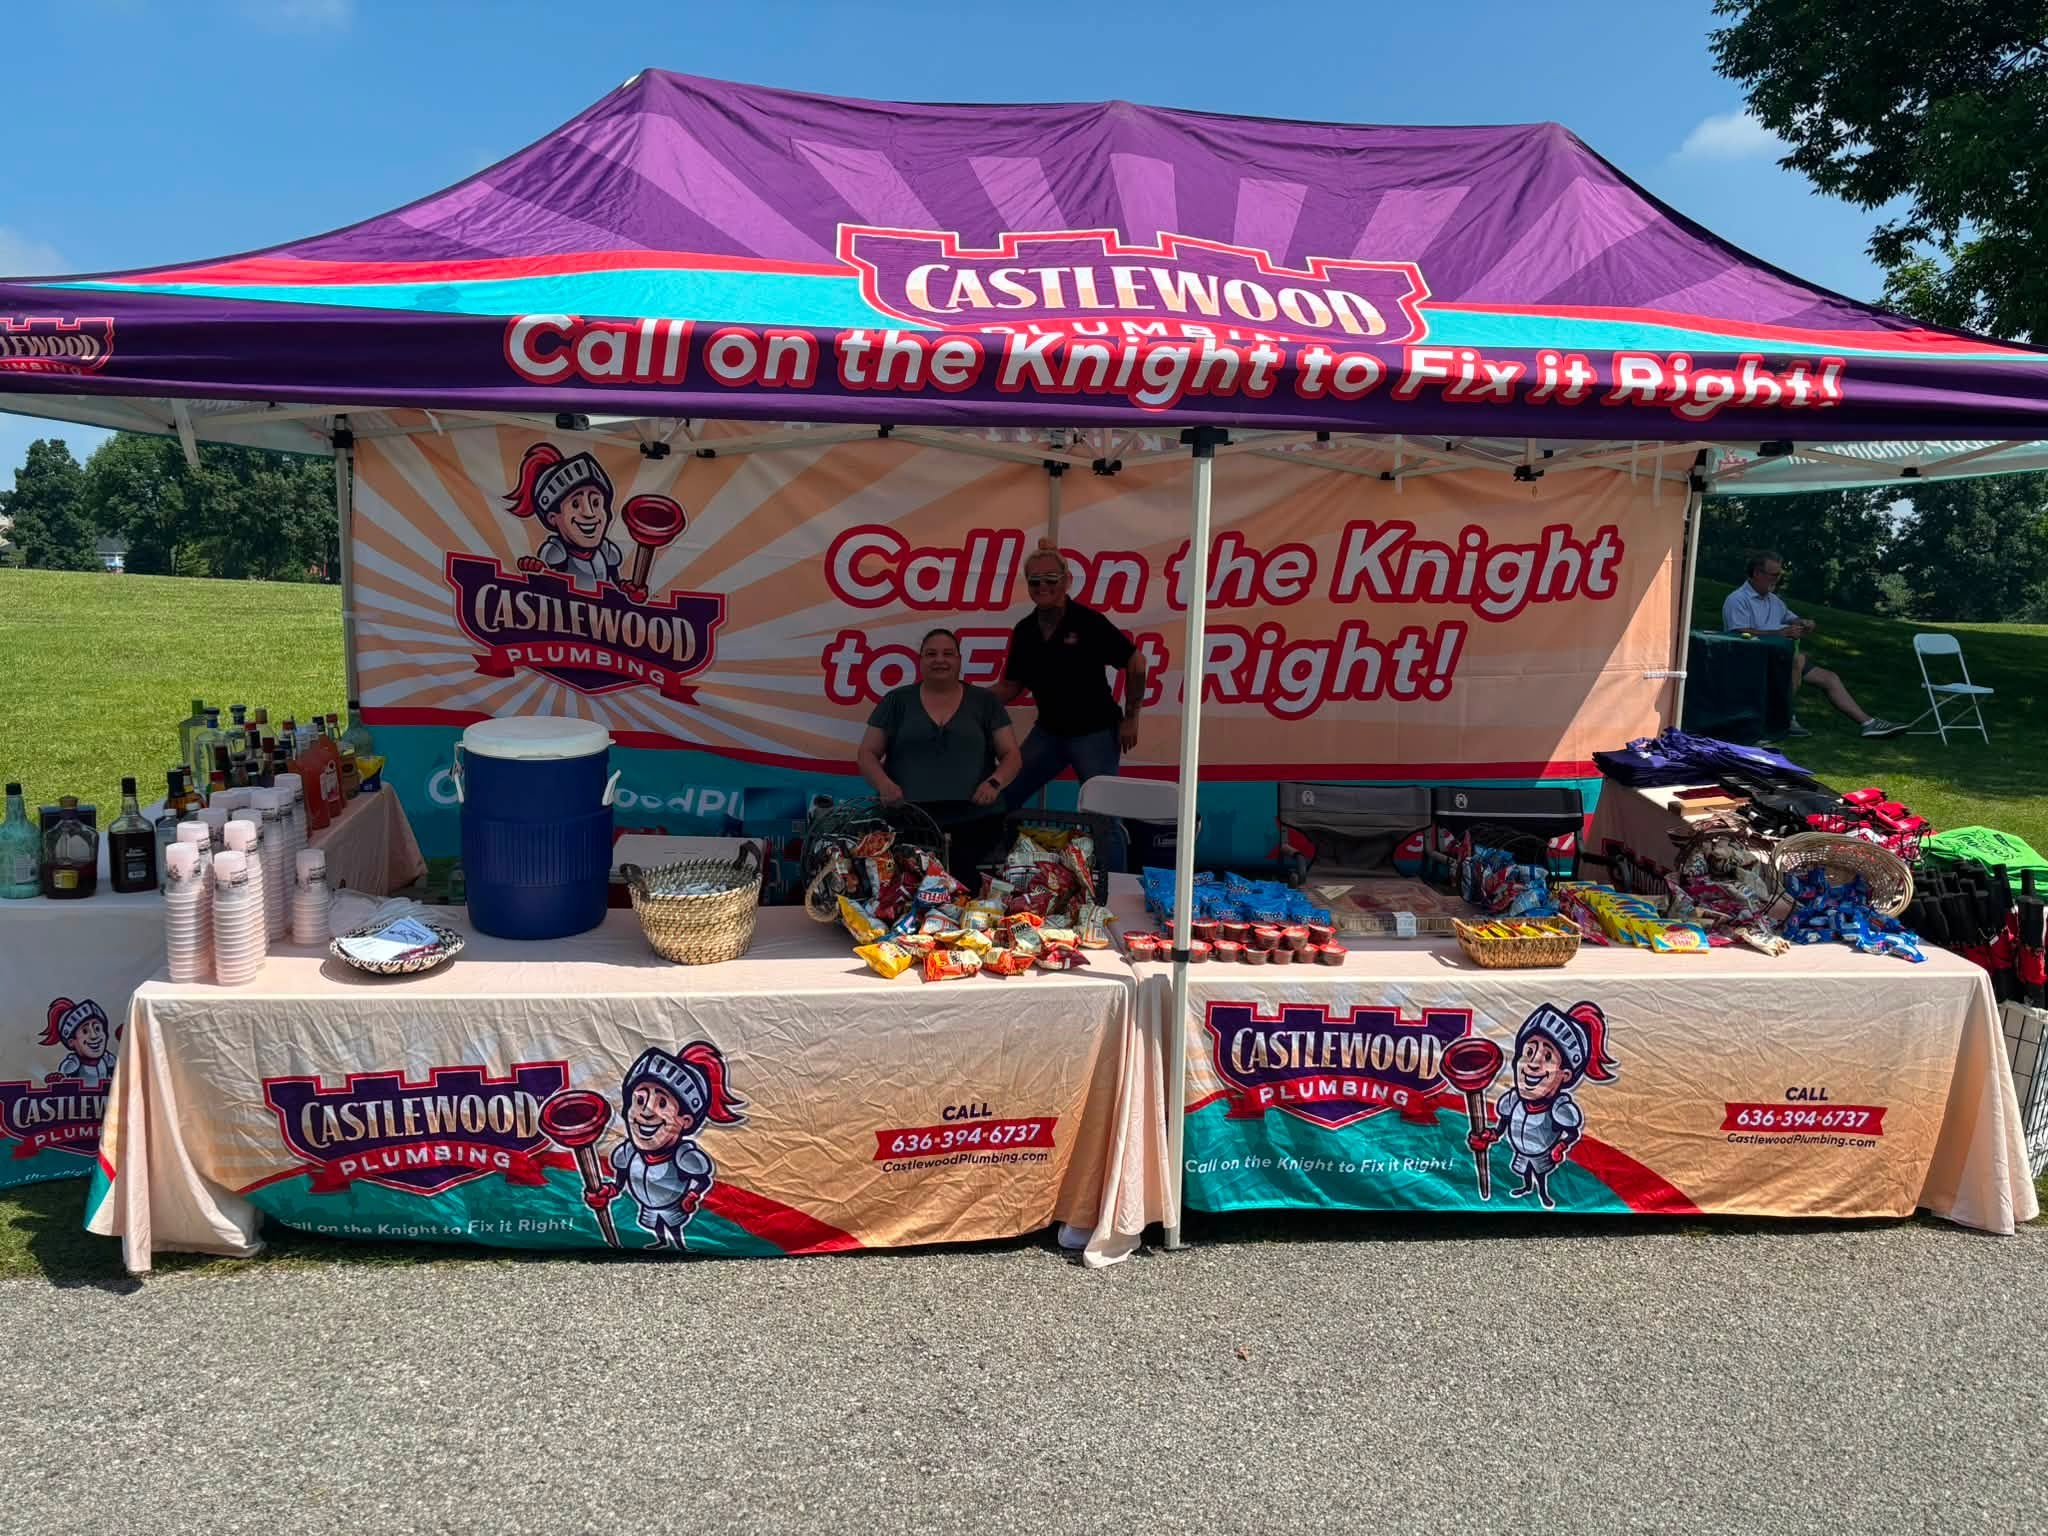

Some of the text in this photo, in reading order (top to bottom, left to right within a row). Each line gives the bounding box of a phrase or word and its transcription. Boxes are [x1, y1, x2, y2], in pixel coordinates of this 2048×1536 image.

[905, 263, 1387, 337] CASTLEWOOD
[511, 315, 1842, 416] Call on the Knight to Fix it Right!
[833, 532, 1016, 603] Call
[1172, 538, 1310, 601] the
[1337, 527, 1618, 614] Knight
[474, 583, 696, 662] CASTLEWOOD
[506, 648, 666, 685] PLUMBING
[830, 637, 918, 699] to
[1196, 628, 1461, 713] Right!
[1230, 1027, 1442, 1081] CASTLEWOOD
[1259, 1078, 1411, 1106] PLUMBING
[1785, 1087, 1829, 1101] CALL
[301, 1090, 540, 1149] CASTLEWOOD
[942, 1103, 993, 1121] CALL
[1727, 1133, 1876, 1148] CastlewoodPlumbing.com
[340, 1145, 511, 1177] PLUMBING
[882, 1151, 1048, 1173] CastlewoodPlumbing.com
[1185, 1155, 1456, 1177] Call on the Knight to Fix it Right!
[317, 1224, 339, 1233] on
[343, 1224, 372, 1234] the
[378, 1222, 438, 1237] Knight
[443, 1224, 462, 1235] to
[467, 1218, 495, 1234] Fix
[500, 1217, 513, 1233] it
[518, 1216, 575, 1233] Right!
